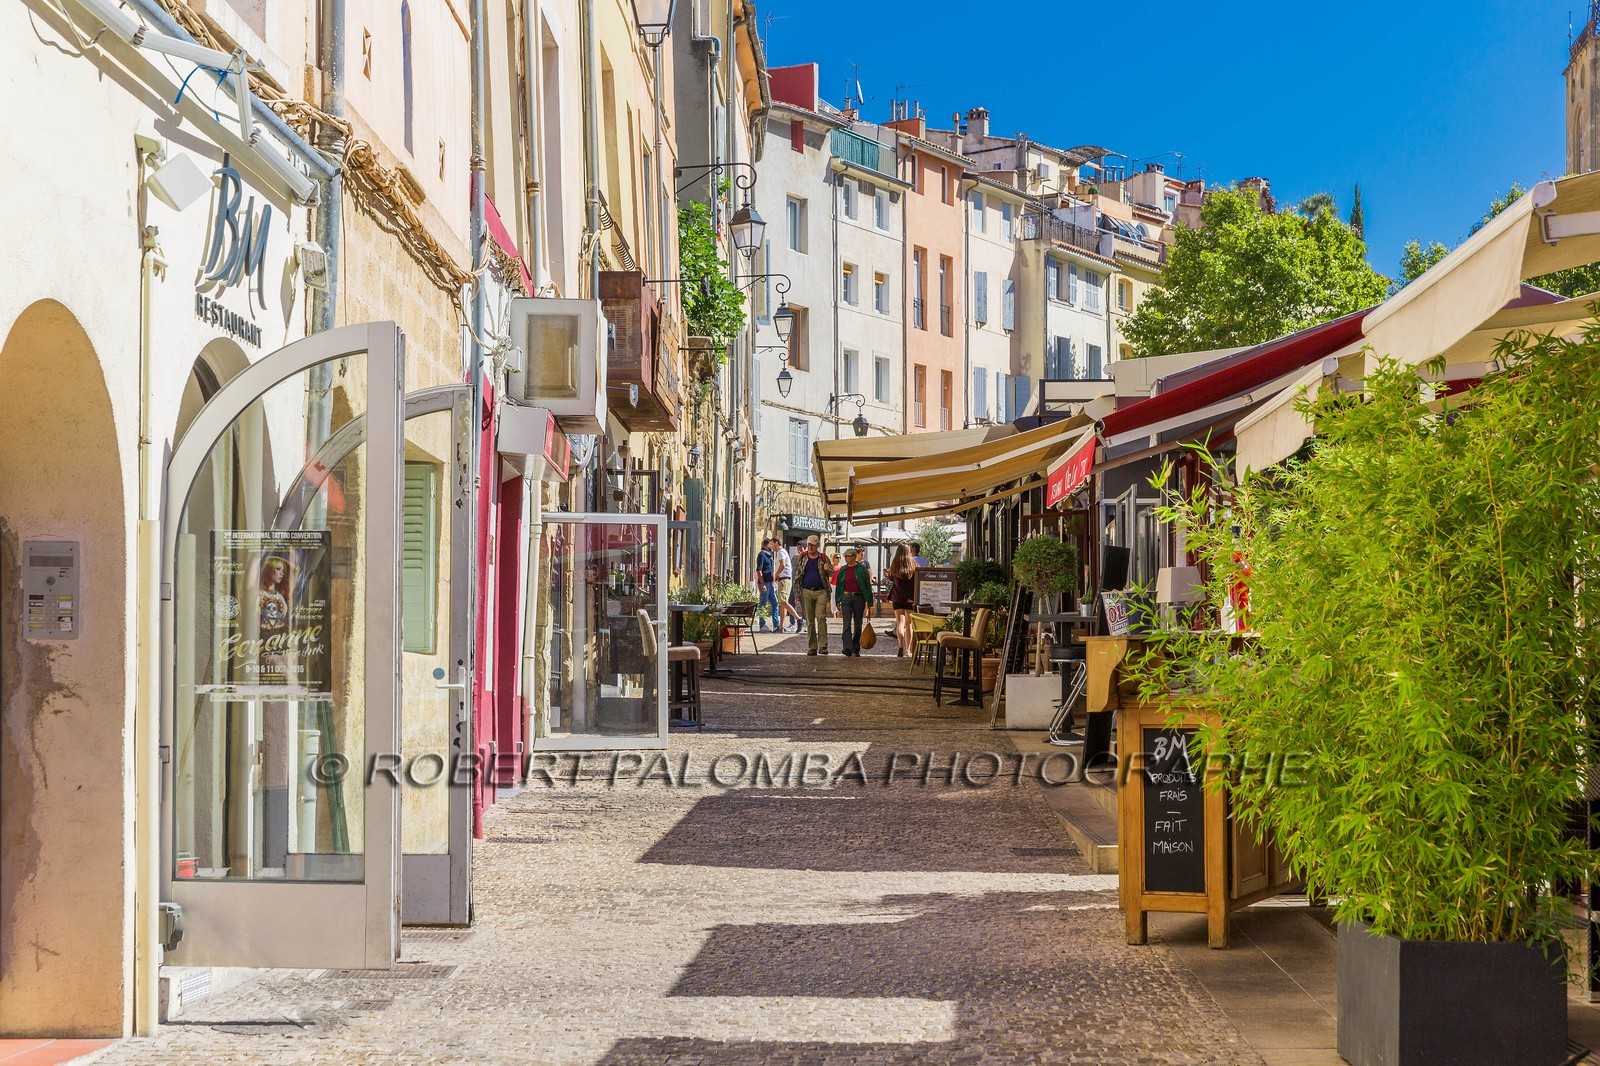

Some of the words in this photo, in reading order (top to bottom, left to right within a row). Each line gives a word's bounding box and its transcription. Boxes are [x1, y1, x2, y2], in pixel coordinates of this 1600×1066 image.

[205, 152, 271, 310] BM
[195, 292, 263, 349] RESTAURANT
[232, 531, 271, 540] INTERNATIONAL
[271, 531, 290, 540] TATTOO
[290, 531, 322, 540] CONVENTION
[288, 664, 305, 674] 2015
[1154, 734, 1191, 762] BM
